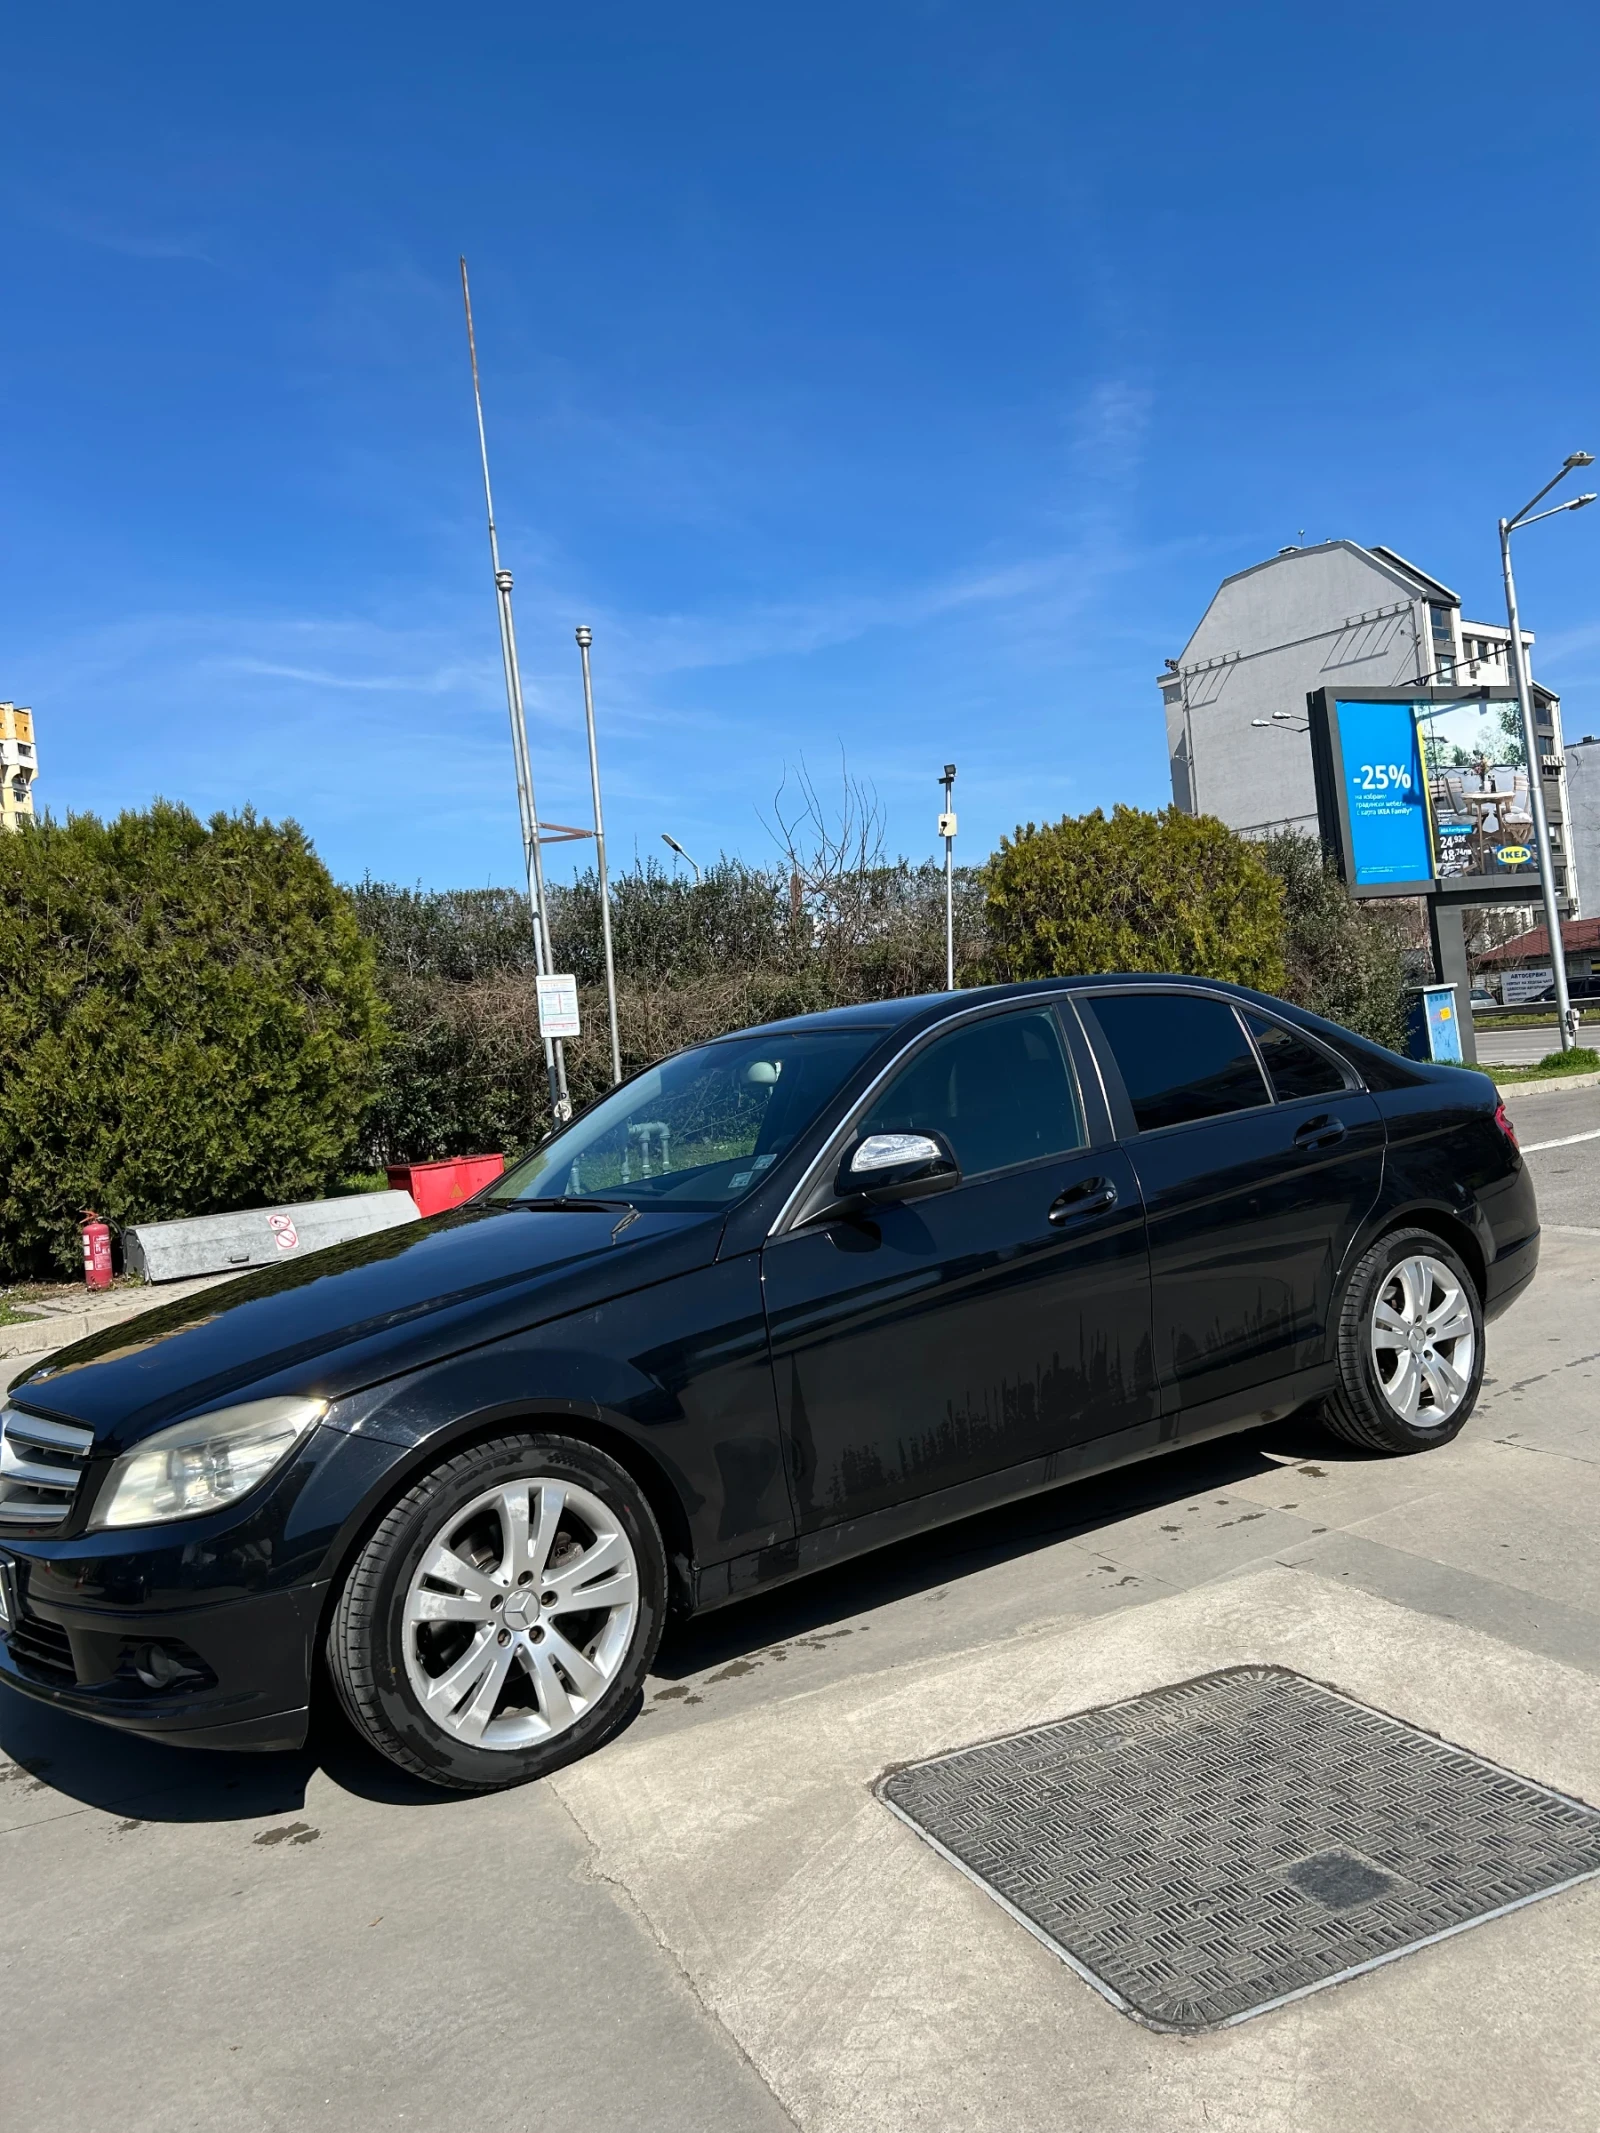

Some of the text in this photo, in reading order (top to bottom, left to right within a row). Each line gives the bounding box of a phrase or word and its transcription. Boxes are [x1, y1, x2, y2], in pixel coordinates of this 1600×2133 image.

[1353, 764, 1411, 789] -25%
[1363, 793, 1387, 801] избрани
[1361, 809, 1376, 817] карта
[1501, 850, 1529, 859] IKEA
[1511, 971, 1546, 979] АВТОСЕРВИЗ
